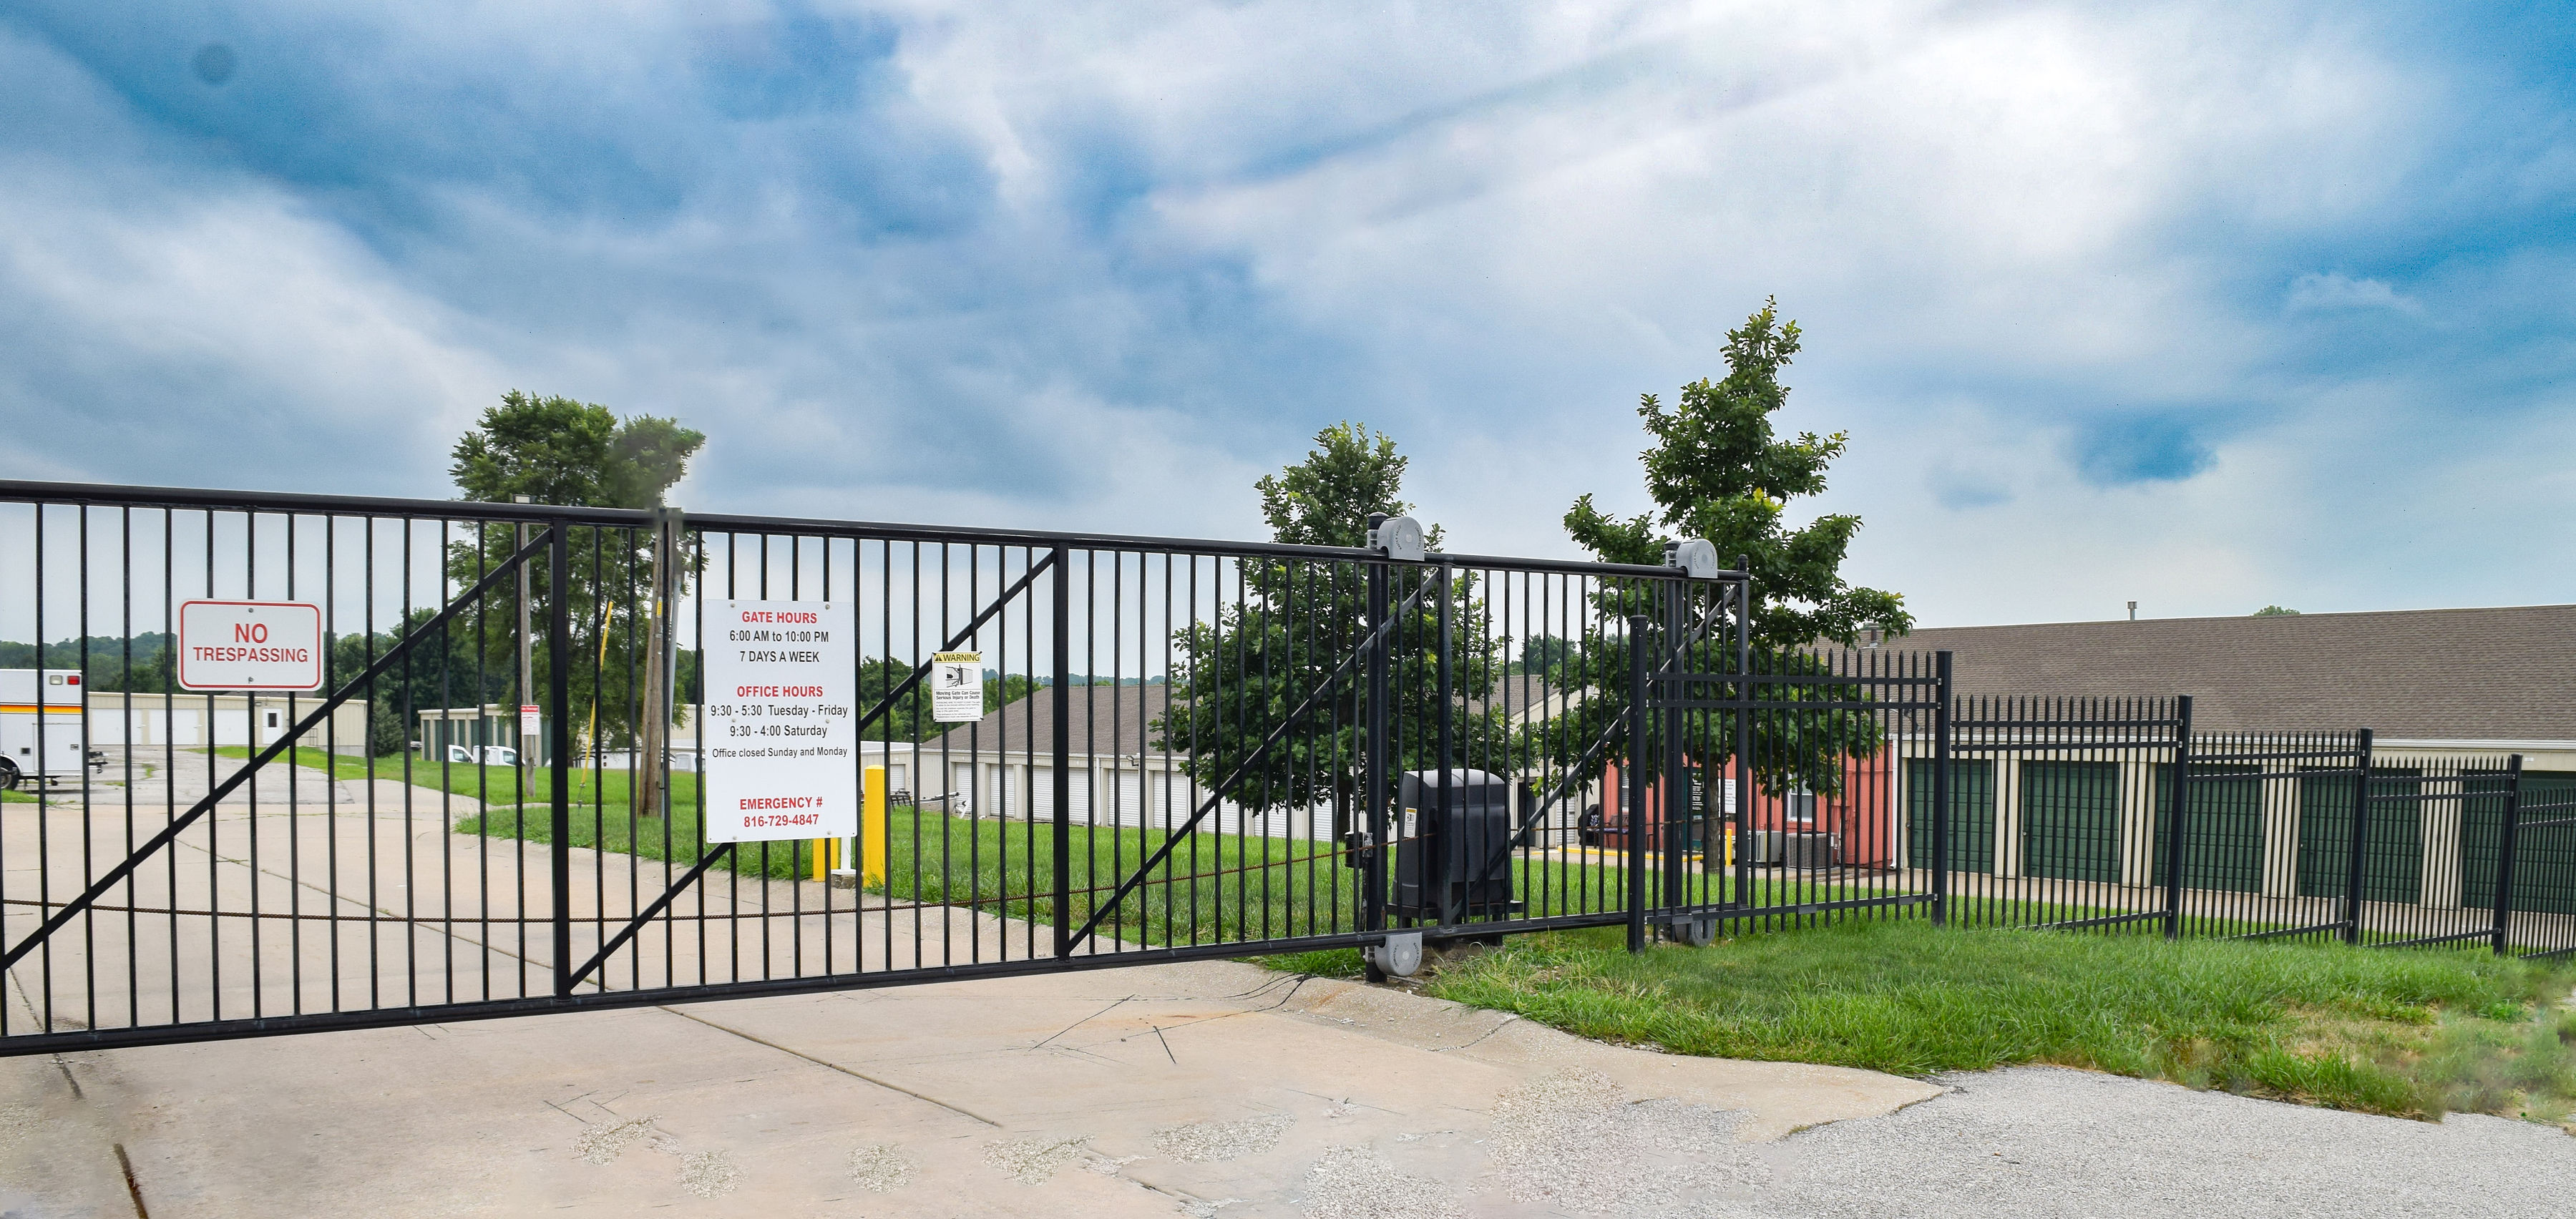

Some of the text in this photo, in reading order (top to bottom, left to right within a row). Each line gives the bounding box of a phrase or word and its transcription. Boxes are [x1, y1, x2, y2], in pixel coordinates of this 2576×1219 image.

[742, 612, 816, 624] GATE HOURS
[235, 624, 268, 643] NO
[730, 630, 829, 642] 6:00 AM to 10:00 PM
[193, 647, 307, 662] TRESPASSING
[740, 651, 819, 662] 7 DAYS A WEEK
[737, 686, 823, 697] OFFICE HOURS
[711, 705, 731, 716] 9:30
[741, 705, 761, 715] 5:30
[768, 705, 809, 718] Tuesday
[819, 705, 848, 718] Friday
[731, 725, 751, 736] 9:30
[761, 725, 781, 736] 4:00
[784, 725, 827, 738] Saturday
[713, 748, 736, 758] Office
[739, 748, 765, 757] closed
[768, 748, 797, 758] Sunday
[817, 747, 847, 758] Monday
[740, 797, 822, 810] EMERGENCY #
[744, 814, 819, 827] 816-729-4847
